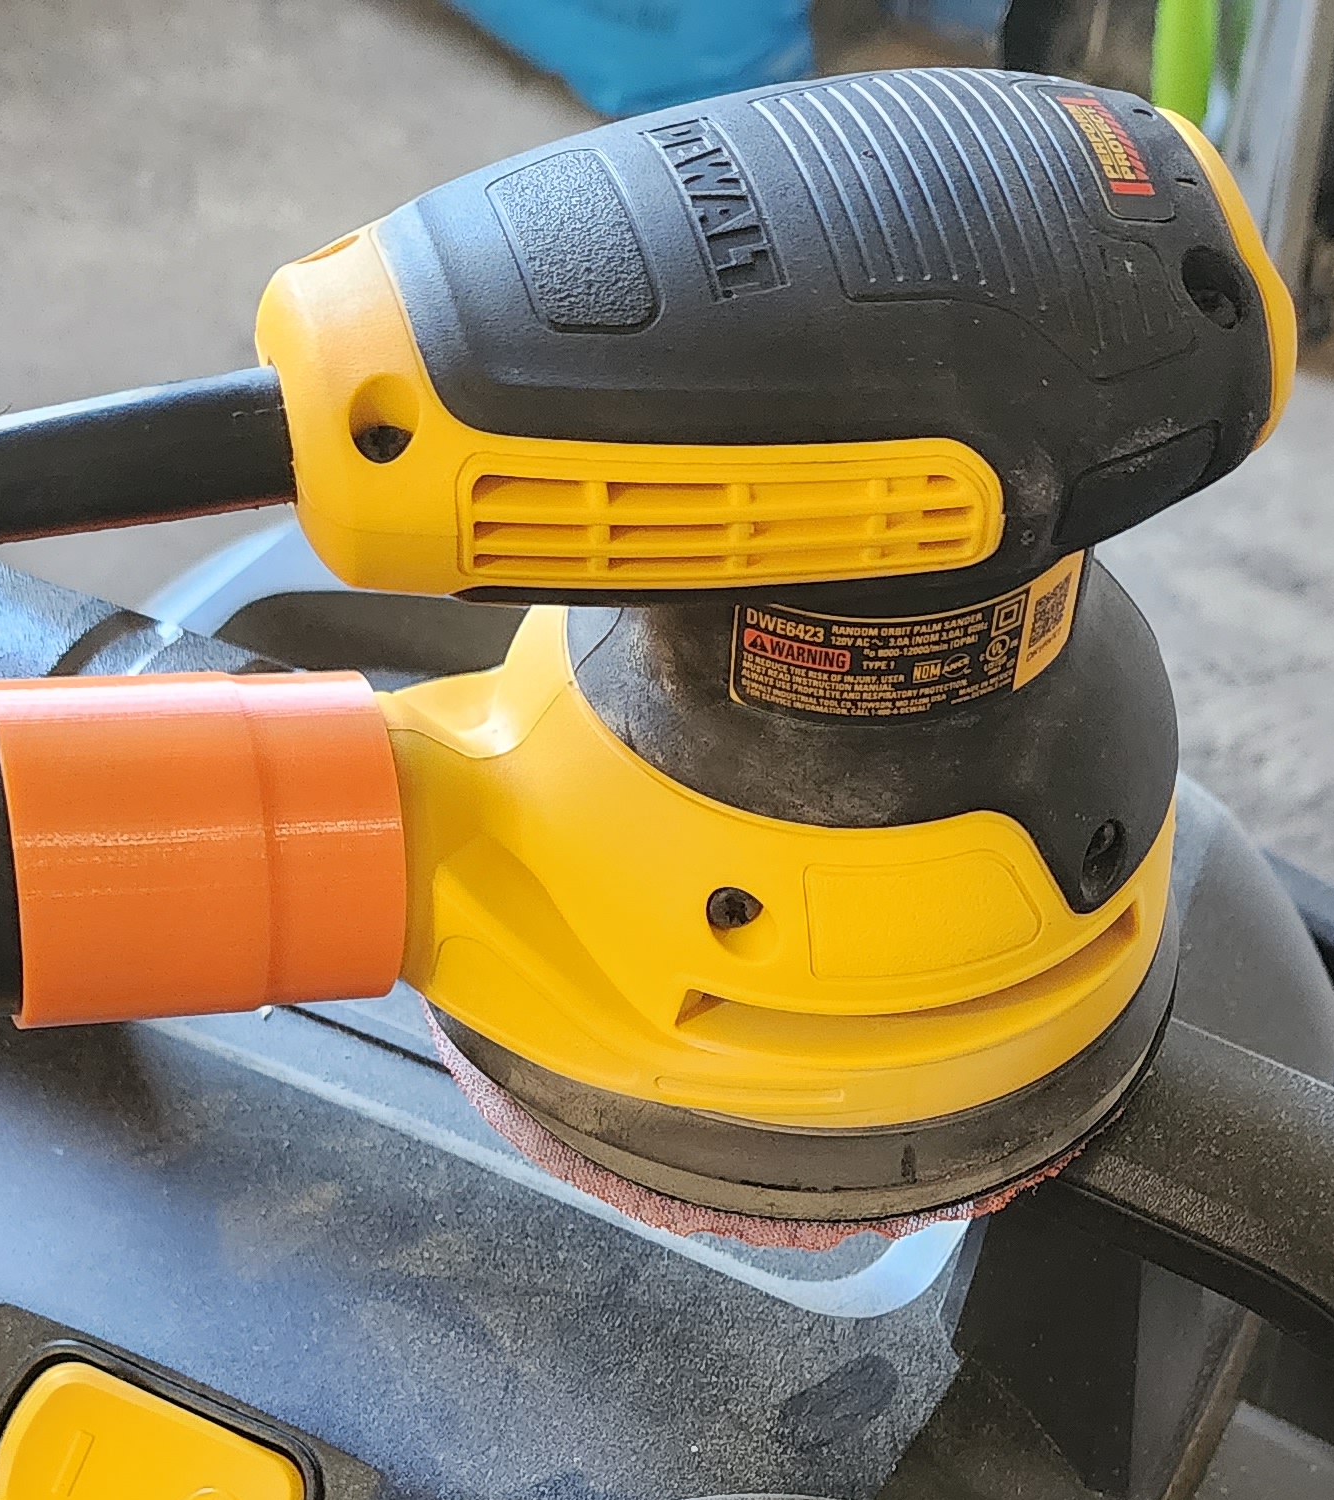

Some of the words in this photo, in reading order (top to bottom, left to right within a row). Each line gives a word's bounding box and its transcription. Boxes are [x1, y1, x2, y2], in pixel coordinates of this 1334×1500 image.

[1063, 104, 1120, 179] PERFORM
[1081, 105, 1137, 180] PROTECT
[746, 607, 825, 643] DWE6423
[831, 625, 879, 637] RANDOM
[880, 626, 912, 637] ORBIT
[913, 622, 942, 634] PALM
[943, 612, 983, 629] SANDER
[769, 638, 847, 670] WARNING
[831, 636, 854, 646] 120V
[742, 651, 754, 662] TO
[755, 655, 789, 674] REDUCE
[789, 666, 807, 677] THE
[808, 669, 829, 681] RISK
[830, 673, 843, 682] OF
[880, 674, 905, 683] USER
[742, 660, 766, 675] MUST
[767, 668, 791, 682] READ
[792, 675, 853, 691] INSTRUCTION
[862, 660, 889, 671] TYPE
[890, 660, 896, 670] 1
[913, 661, 942, 682] NOM
[741, 668, 774, 686] ALWAYS
[775, 680, 792, 691] USE
[792, 684, 825, 697] PROPER
[825, 690, 841, 699] EYE
[842, 691, 861, 700] AND
